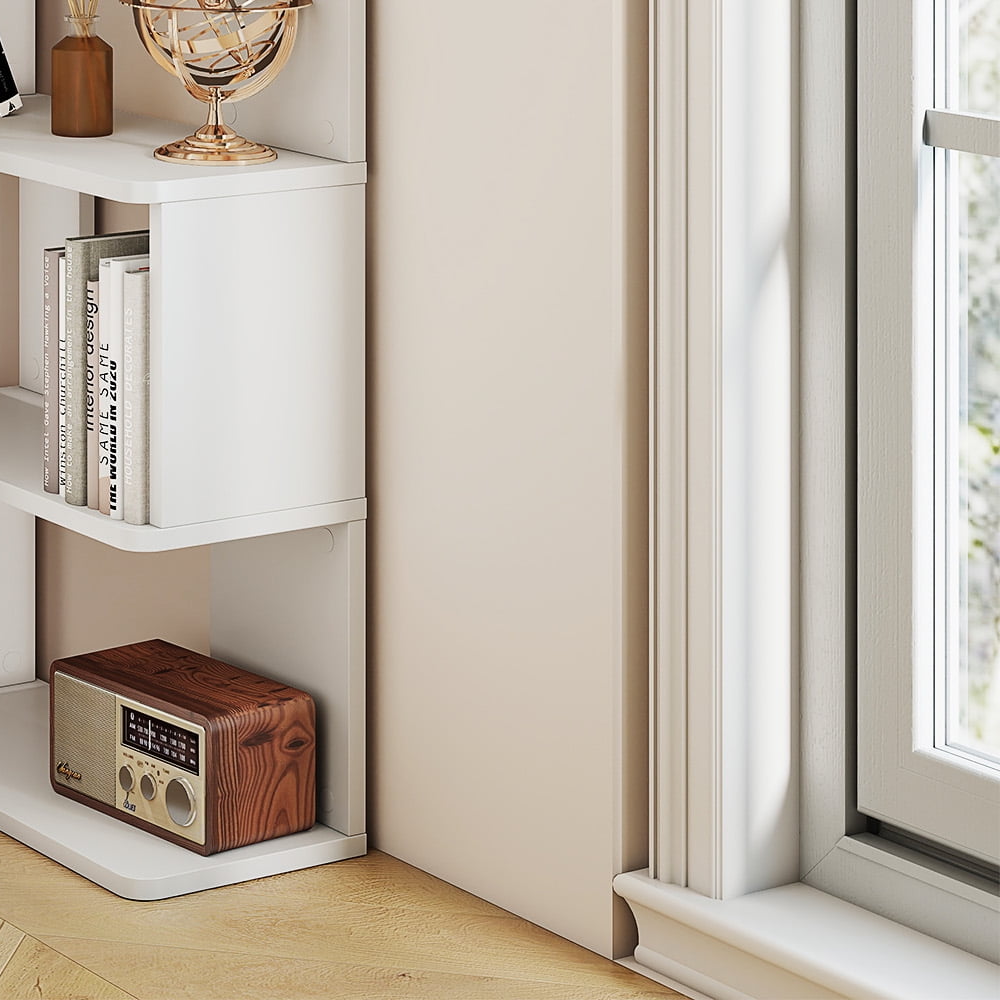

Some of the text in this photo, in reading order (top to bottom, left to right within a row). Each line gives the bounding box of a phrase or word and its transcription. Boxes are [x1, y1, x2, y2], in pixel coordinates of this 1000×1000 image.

[66, 309, 73, 321] in
[66, 328, 74, 398] arrangement
[67, 405, 73, 417] an
[99, 343, 109, 466] SAME SAME
[124, 307, 133, 486] HOUSEHOLD DECORATES
[66, 455, 73, 466] to
[109, 424, 117, 480] WORLD
[109, 484, 117, 510] THE
